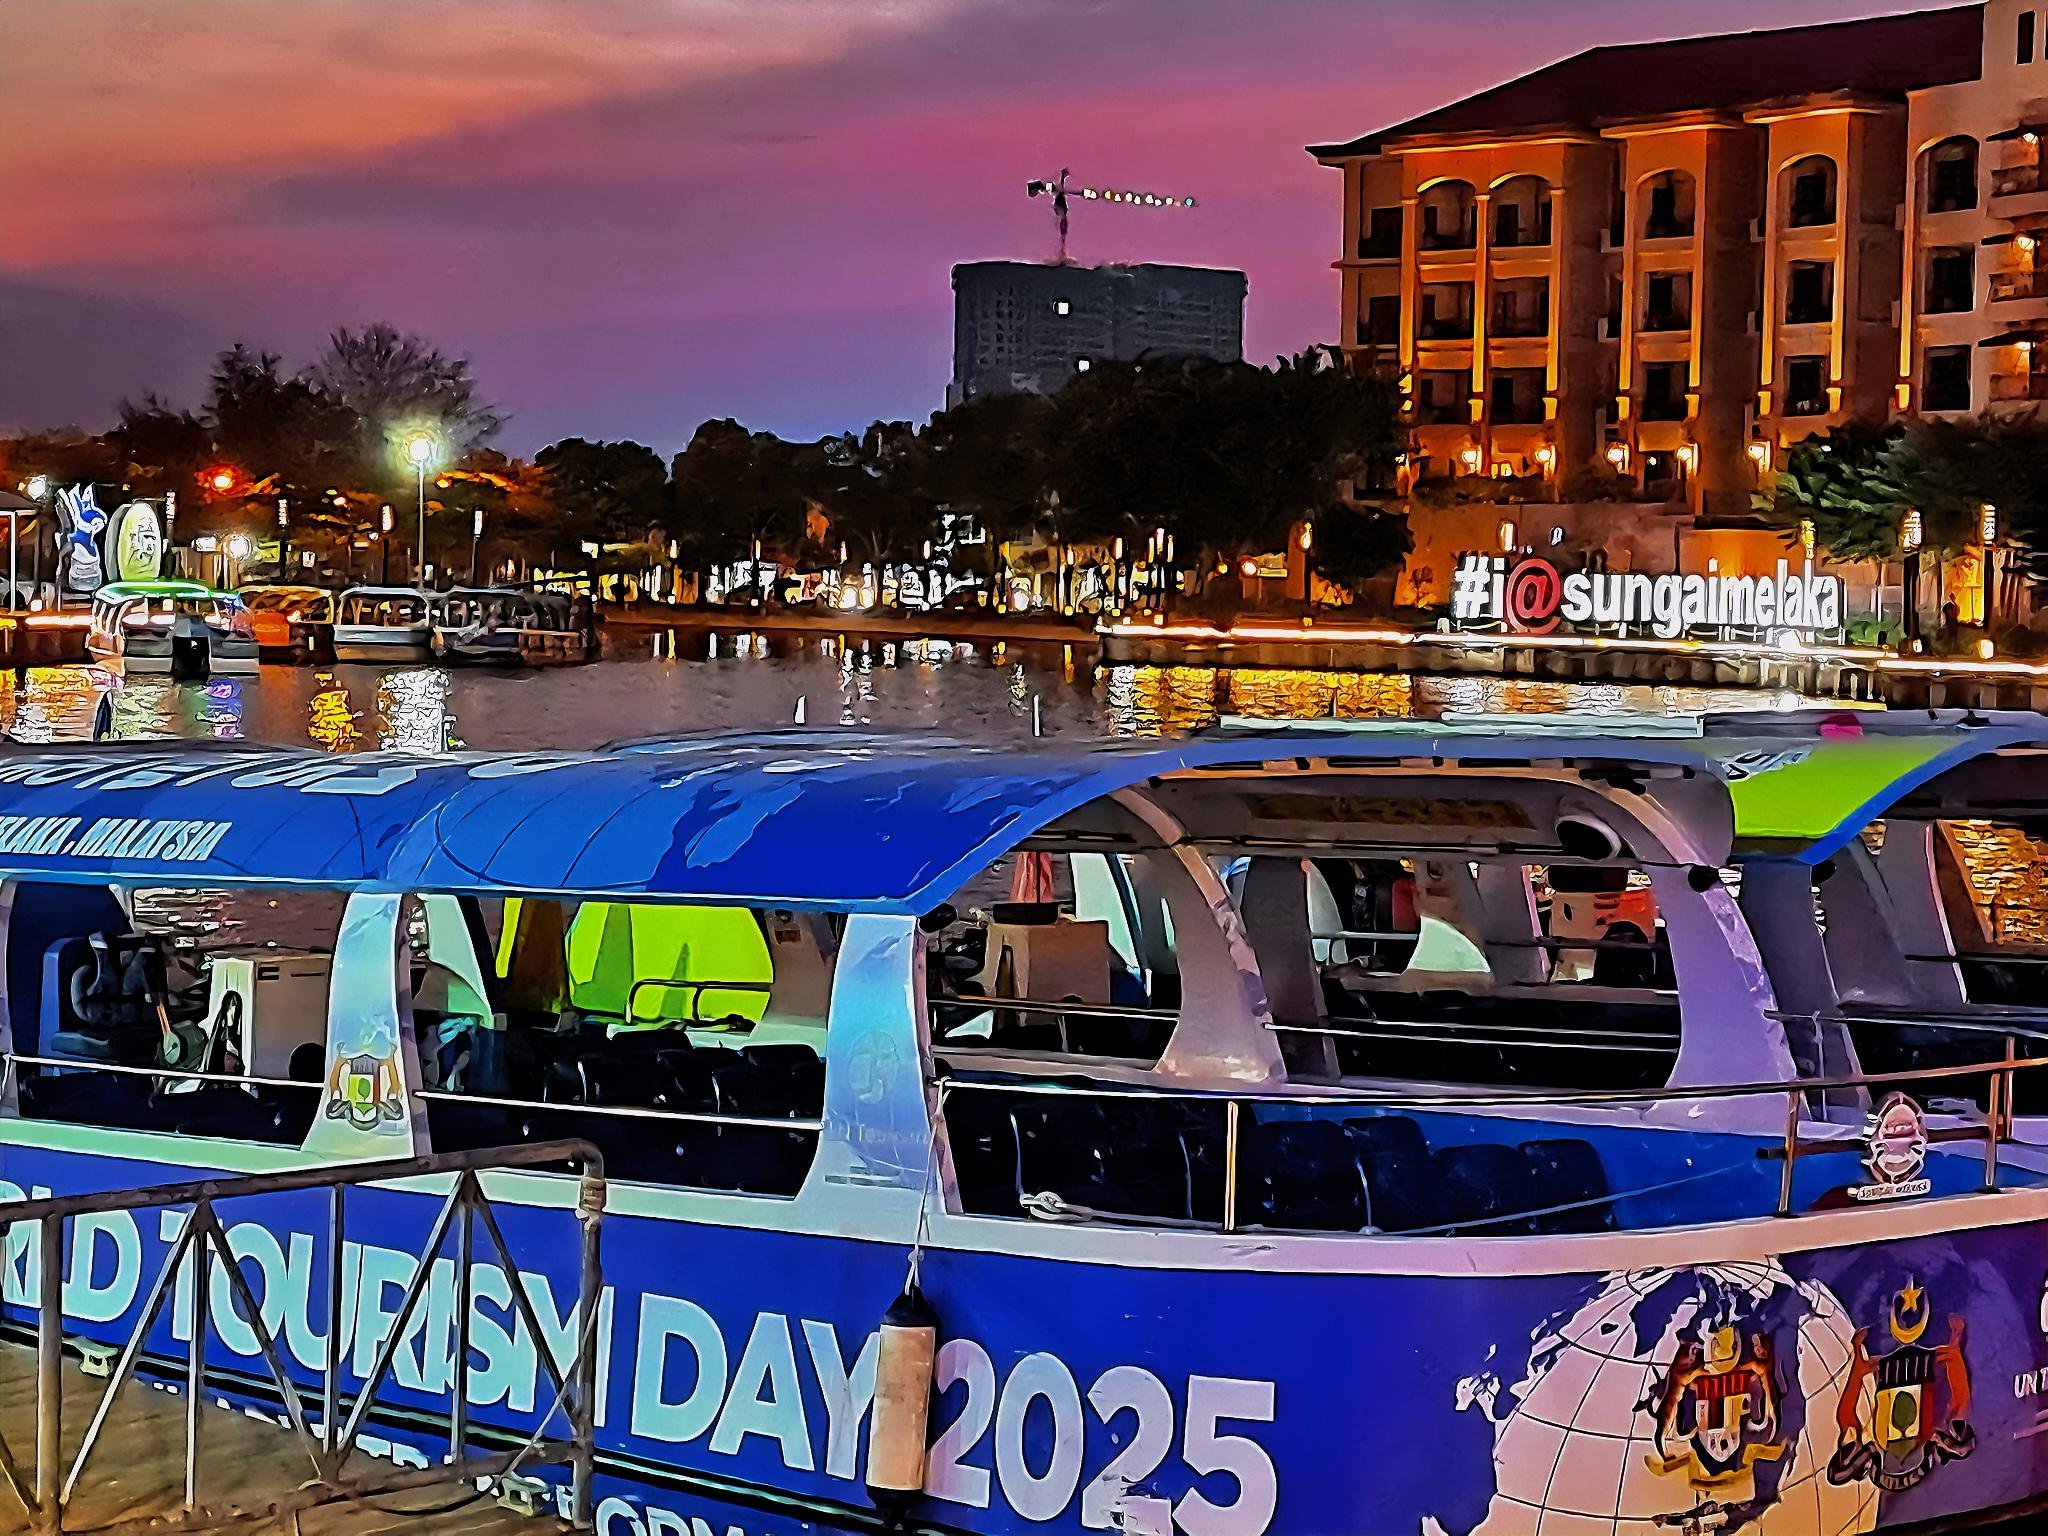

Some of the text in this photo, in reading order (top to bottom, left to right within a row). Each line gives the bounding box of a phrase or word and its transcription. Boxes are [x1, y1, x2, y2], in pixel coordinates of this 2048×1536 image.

[1454, 554, 1840, 640] #i@sungaimelaka
[71, 817, 233, 861] MALAYSIA
[159, 1207, 614, 1429] TOURISM
[629, 1292, 884, 1481] DAY
[923, 1337, 1279, 1536] 2025
